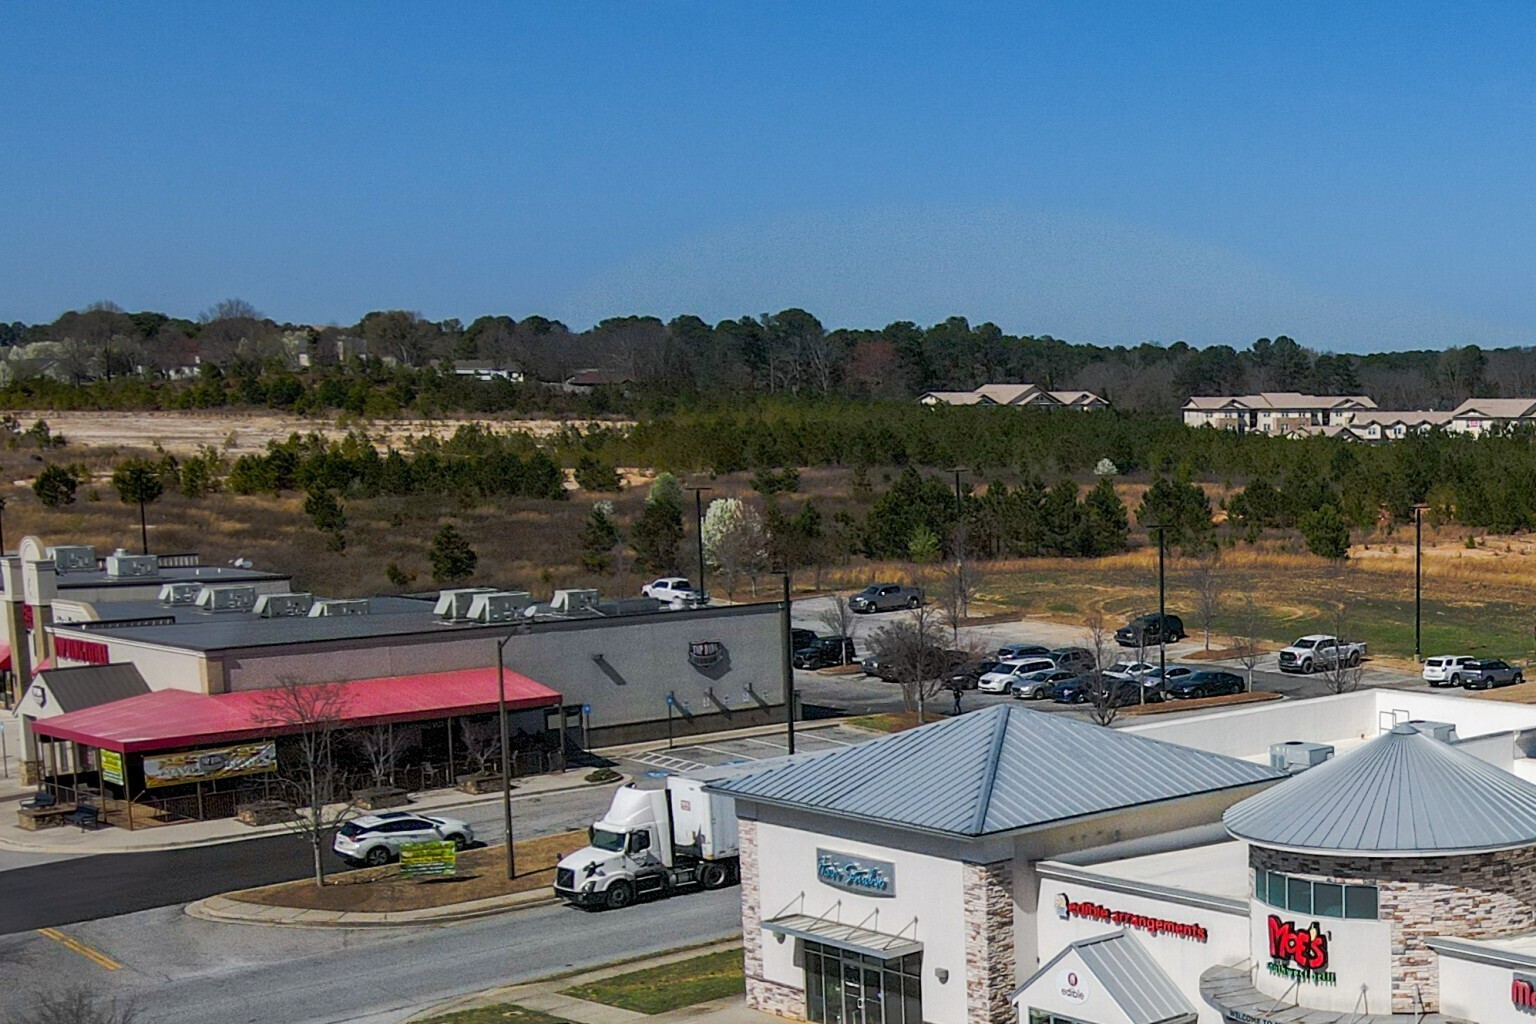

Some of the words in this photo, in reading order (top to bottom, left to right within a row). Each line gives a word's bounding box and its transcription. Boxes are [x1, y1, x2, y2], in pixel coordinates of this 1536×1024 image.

[1069, 902, 1109, 918] edible
[1111, 911, 1207, 941] arrangements
[1061, 987, 1084, 1000] edible
